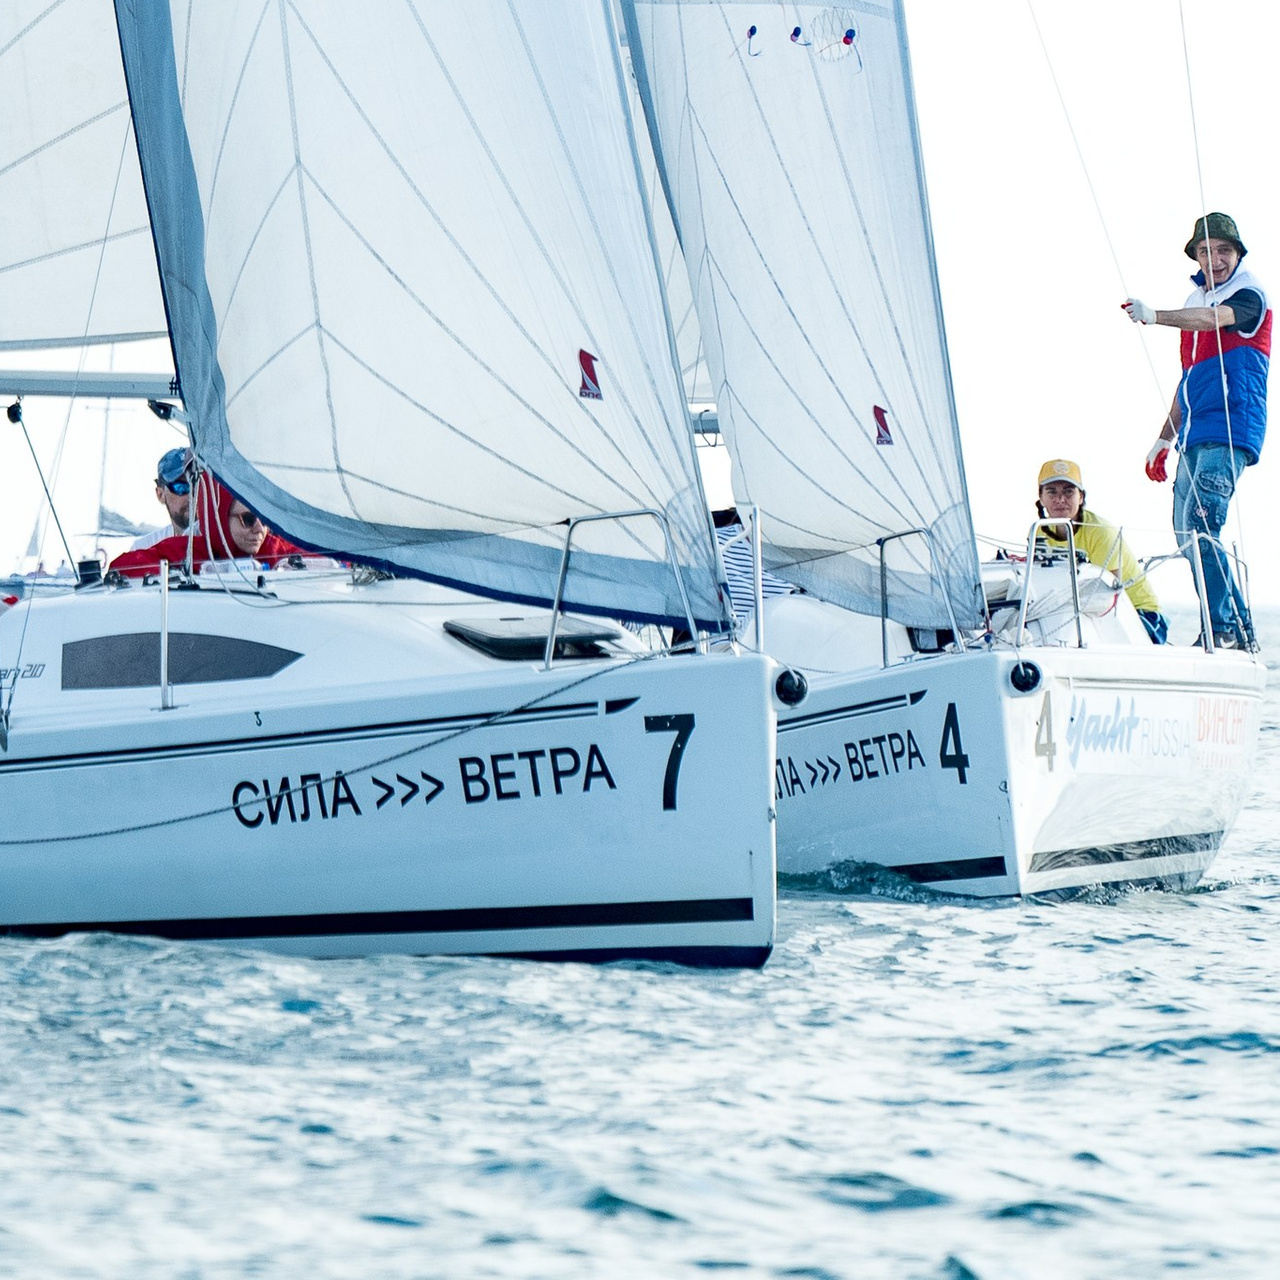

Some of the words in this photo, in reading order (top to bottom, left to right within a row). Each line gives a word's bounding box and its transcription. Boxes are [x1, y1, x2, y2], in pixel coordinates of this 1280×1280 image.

[644, 713, 696, 811] 7
[844, 729, 926, 782] ВЕТРА
[939, 702, 970, 785] 4
[1035, 690, 1057, 772] 4
[1141, 717, 1192, 758] RUSSIA
[232, 770, 362, 829] СИЛА
[459, 743, 617, 805] ВЕТРА
